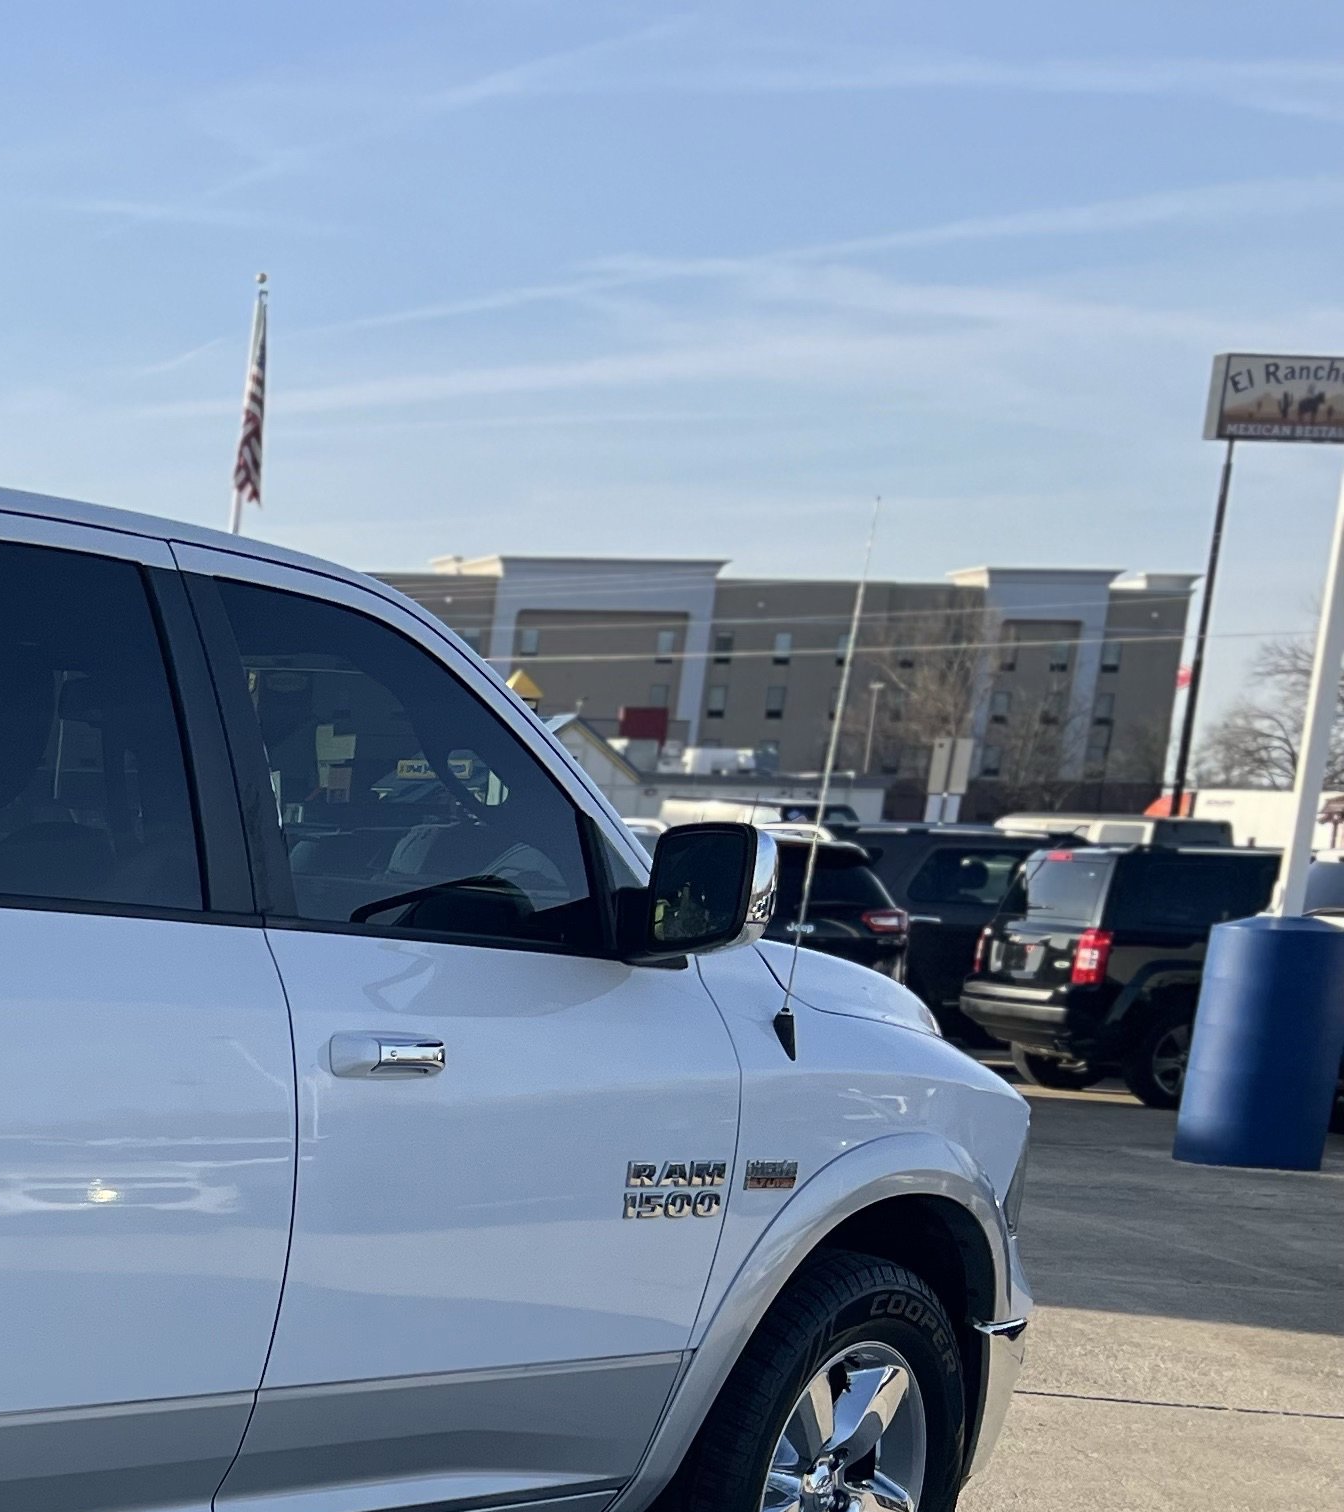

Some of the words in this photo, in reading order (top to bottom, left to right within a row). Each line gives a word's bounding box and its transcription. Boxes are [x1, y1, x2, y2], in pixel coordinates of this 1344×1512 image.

[1230, 368, 1255, 394] El
[1264, 360, 1344, 385] Ranch
[1226, 423, 1291, 437] MEXICAN
[625, 1160, 727, 1187] RAM
[622, 1190, 722, 1219] 1500
[870, 1293, 958, 1376] COOPER
